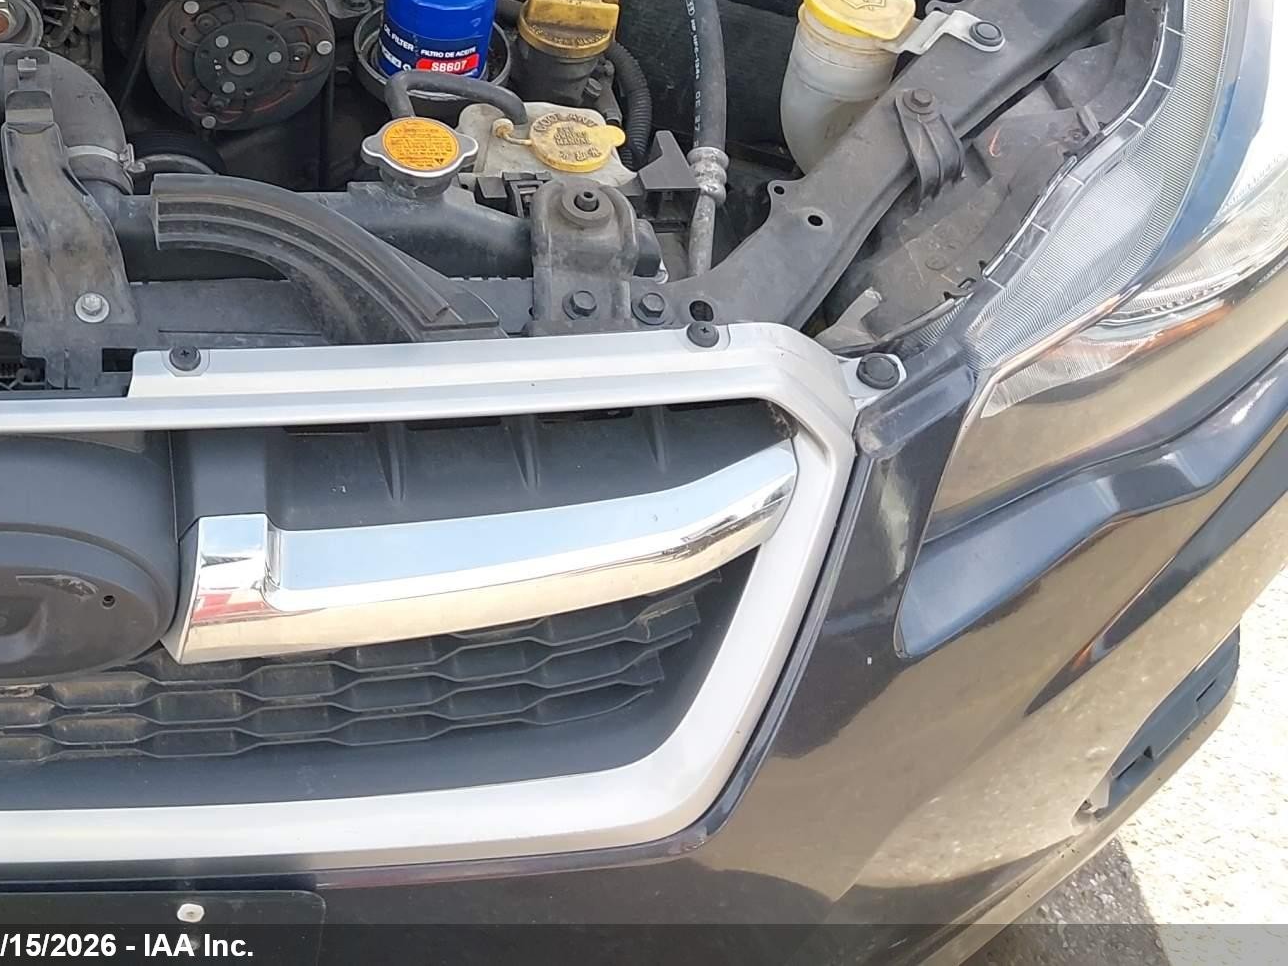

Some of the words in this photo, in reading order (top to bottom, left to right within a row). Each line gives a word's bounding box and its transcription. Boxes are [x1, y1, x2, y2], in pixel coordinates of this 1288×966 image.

[391, 33, 415, 52] FILTER
[420, 49, 444, 58] FILTRO
[455, 46, 476, 57] ACEITE
